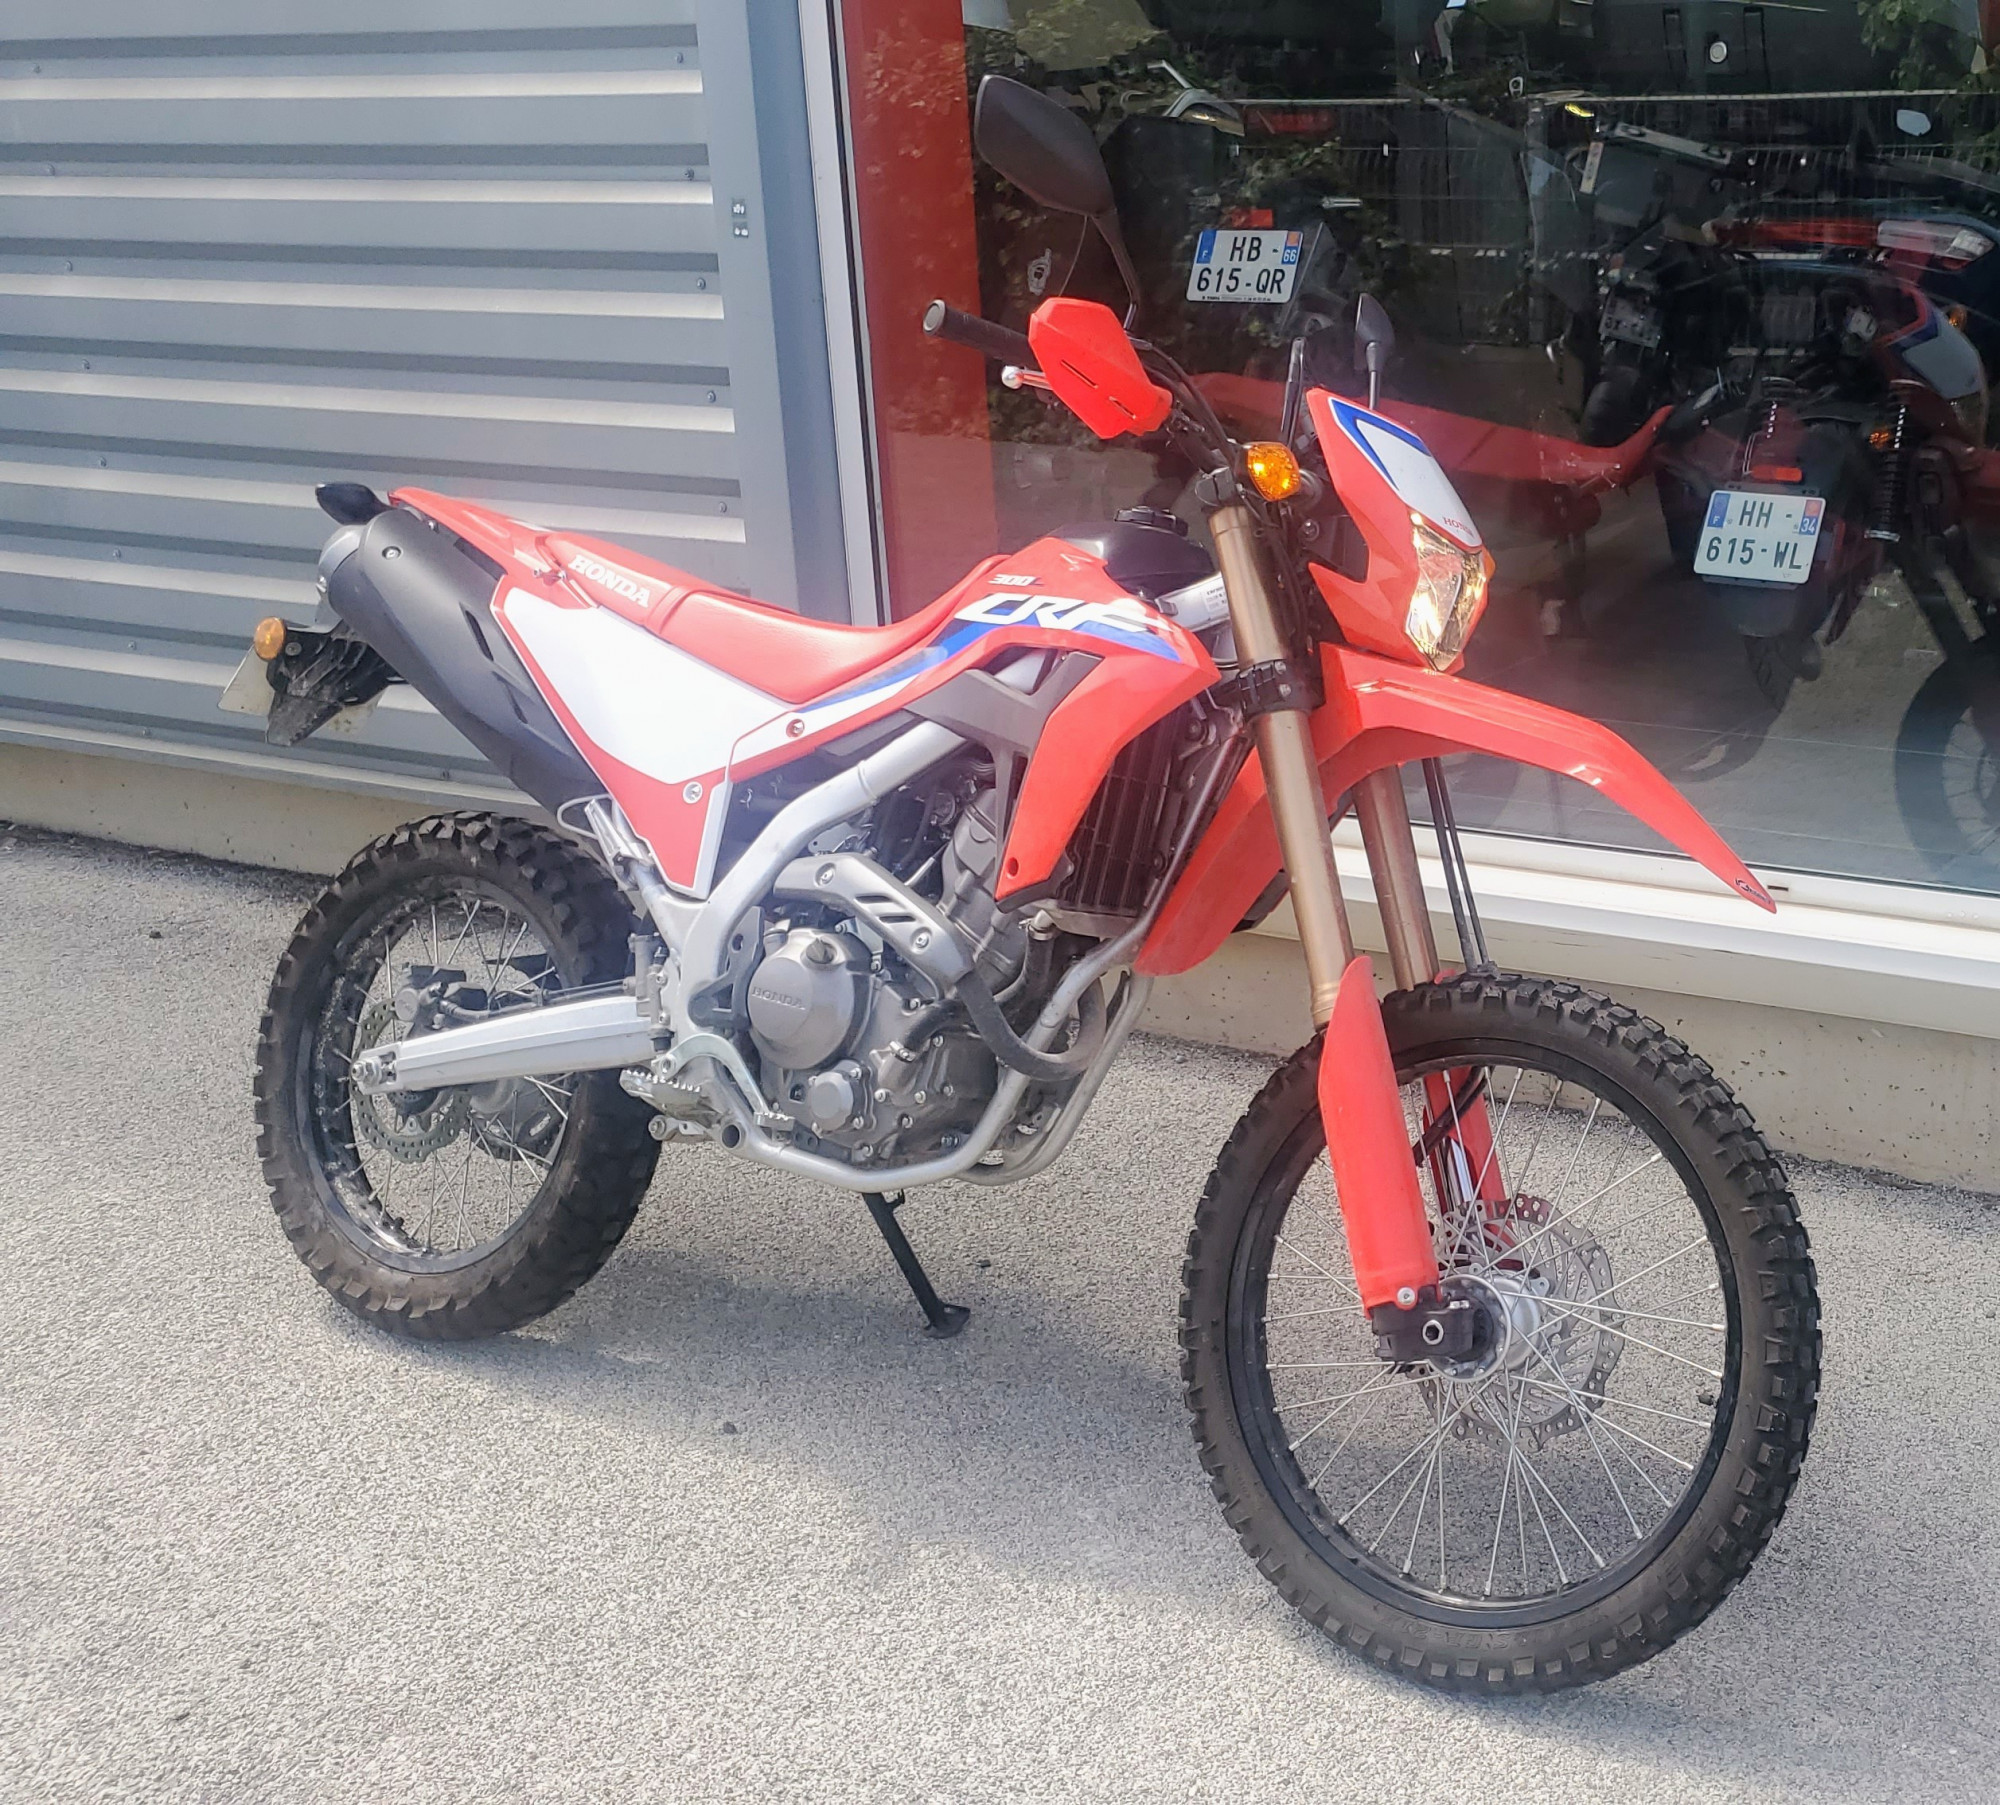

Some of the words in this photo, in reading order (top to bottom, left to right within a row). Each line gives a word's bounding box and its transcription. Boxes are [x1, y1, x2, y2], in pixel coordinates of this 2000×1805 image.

[1283, 249, 1297, 262] 66
[1196, 267, 1286, 294] 615-QR
[1712, 515, 1720, 525] F
[1800, 517, 1816, 534] 34
[1706, 536, 1802, 570] 615-WL
[567, 554, 651, 609] HONDA
